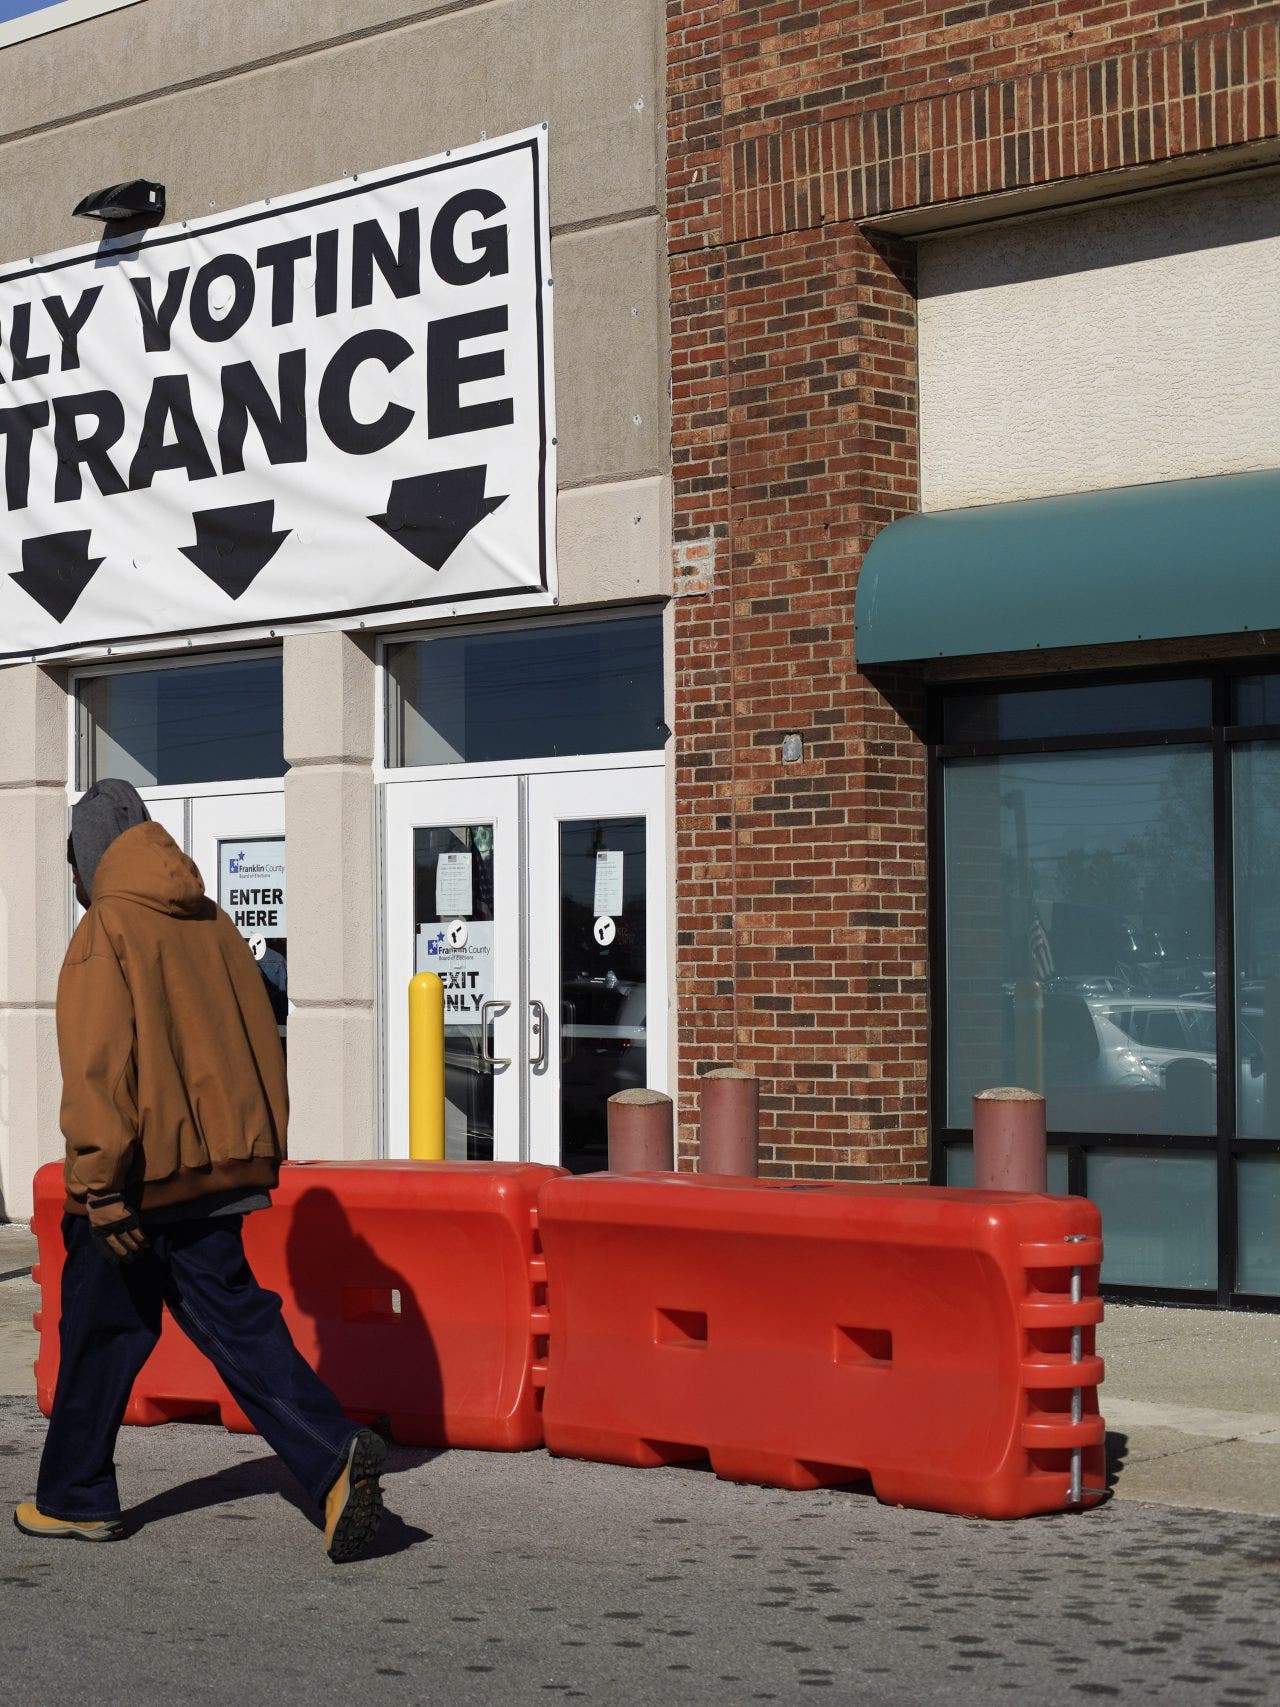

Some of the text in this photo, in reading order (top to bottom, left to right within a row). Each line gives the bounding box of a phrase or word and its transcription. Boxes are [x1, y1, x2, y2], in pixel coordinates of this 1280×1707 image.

[130, 188, 509, 353] VOTING
[239, 864, 284, 874] Franklin County
[230, 888, 283, 905] ENTER
[235, 910, 277, 926] HERE
[468, 945, 490, 956] County
[438, 971, 479, 989] EXIT
[444, 994, 484, 1012] NLY
